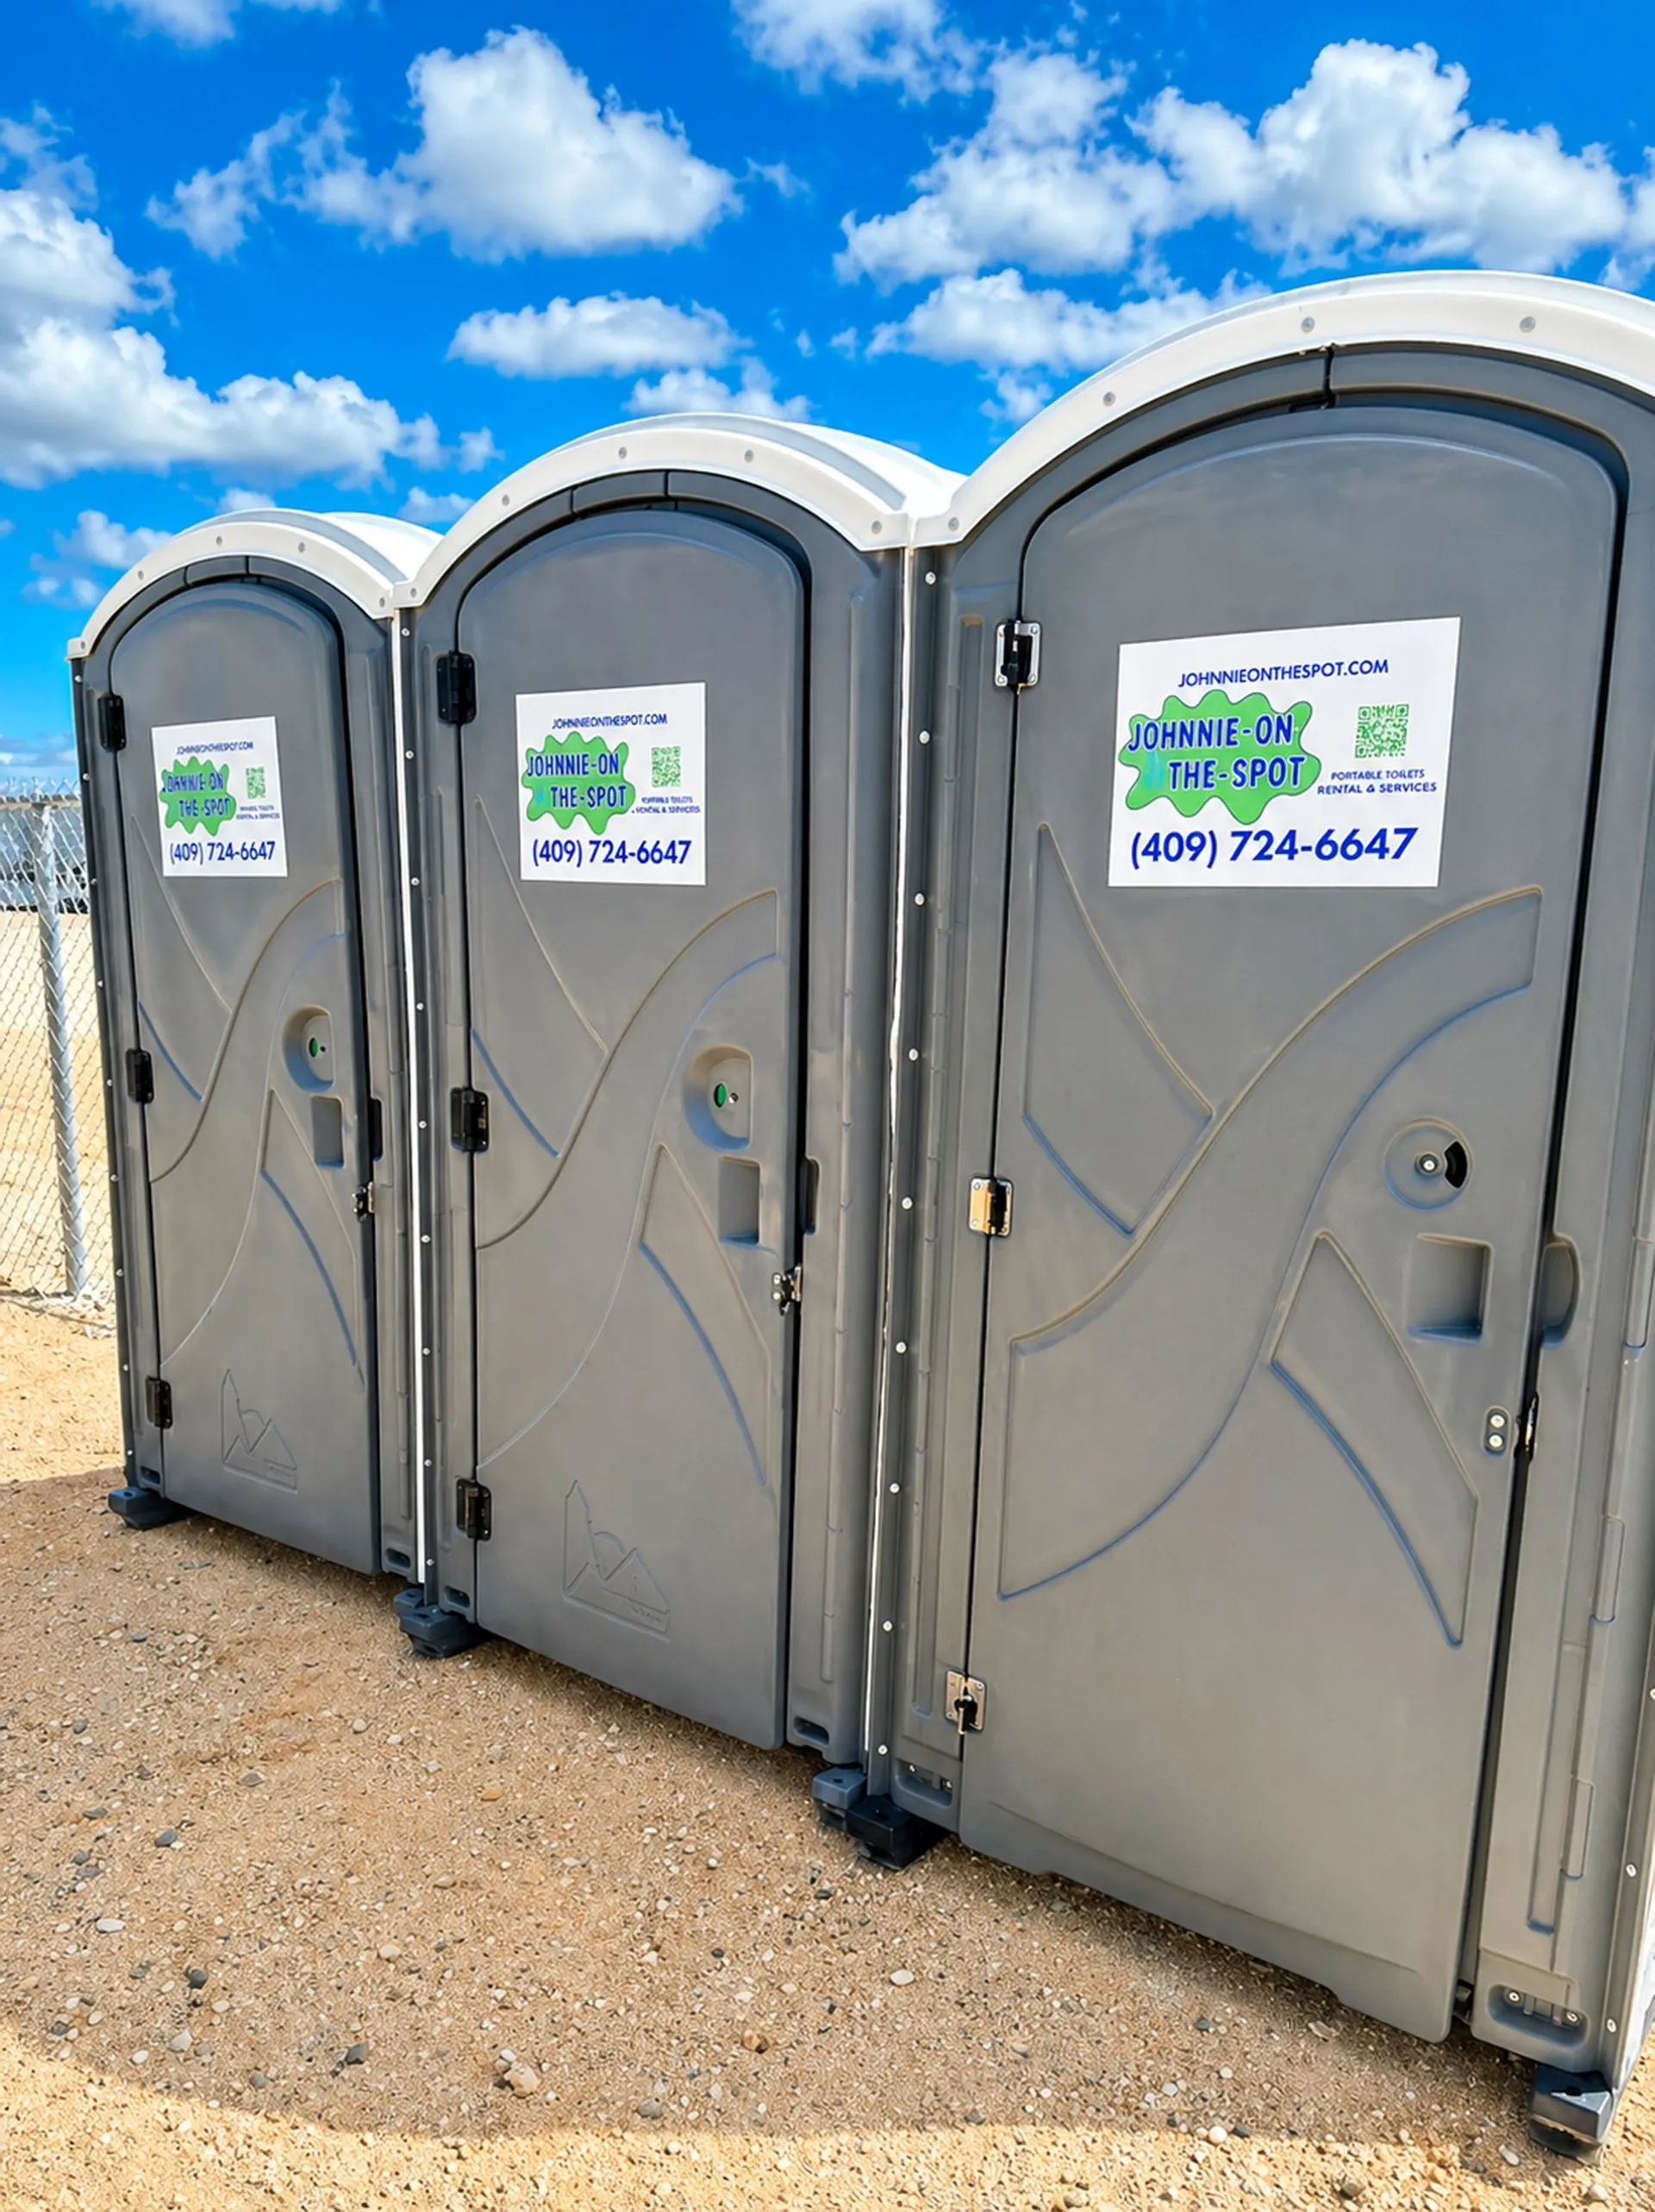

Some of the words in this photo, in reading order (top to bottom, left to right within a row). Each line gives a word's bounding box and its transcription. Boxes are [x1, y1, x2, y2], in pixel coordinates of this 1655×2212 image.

[1177, 659, 1390, 688] JOHNNIEONTHESPOT.COM
[552, 713, 668, 730] JOHNNIEONTHESPOT.COM
[1127, 714, 1294, 752] JOHNNIE-ON
[527, 753, 620, 777] JOHNNIE-ON
[1168, 756, 1305, 791] THE-SPOT
[1330, 770, 1383, 781] PORTABLE
[1385, 768, 1425, 779] TOILETS
[550, 785, 627, 809] THE-SPOT
[1316, 783, 1363, 795] RENTAL
[1378, 781, 1437, 793] SERVICES
[169, 842, 203, 865] (409)
[207, 840, 276, 861] 724-6647
[533, 839, 583, 868] (409)
[589, 839, 692, 864] 724-6647
[1131, 829, 1218, 871] (409)
[1229, 827, 1419, 861] 724-6647
